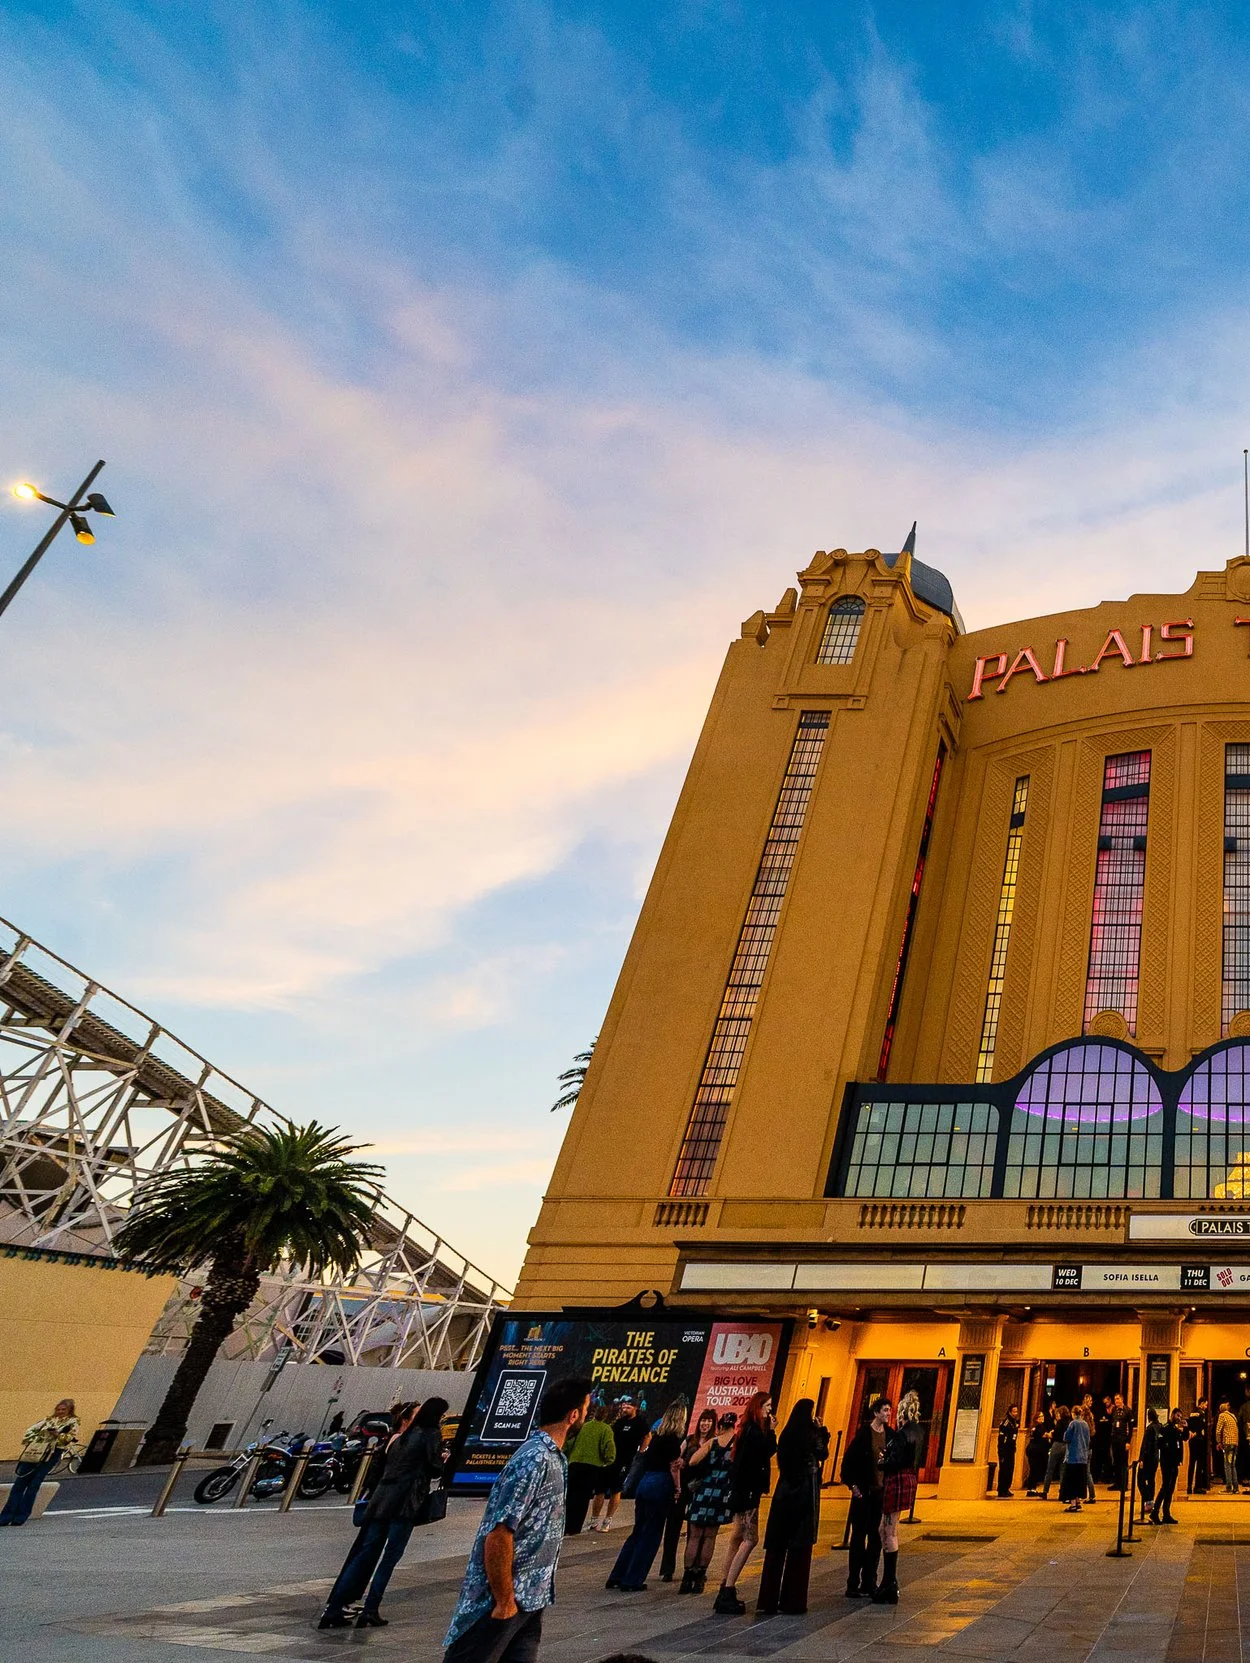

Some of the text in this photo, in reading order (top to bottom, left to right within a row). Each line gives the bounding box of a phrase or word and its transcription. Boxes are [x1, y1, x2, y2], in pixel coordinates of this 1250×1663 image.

[967, 617, 1195, 700] PALAIS
[1201, 1221, 1243, 1233] PALAIS
[1058, 1269, 1077, 1277] WED
[1103, 1273, 1129, 1281] SOFIA
[1187, 1269, 1204, 1277] THU
[1216, 1267, 1232, 1281] SOLD
[1221, 1276, 1234, 1288] OUT
[626, 1331, 655, 1347] THE
[682, 1335, 704, 1343] OPERA
[712, 1332, 773, 1365] UB40
[938, 1347, 946, 1357] A
[1083, 1347, 1090, 1357] B
[591, 1348, 679, 1365] PIRATES OF
[591, 1366, 670, 1382] PENZANCE
[713, 1376, 758, 1386] BIG LOVE
[707, 1386, 759, 1396] AUSTRALIA
[706, 1396, 732, 1406] TOUR
